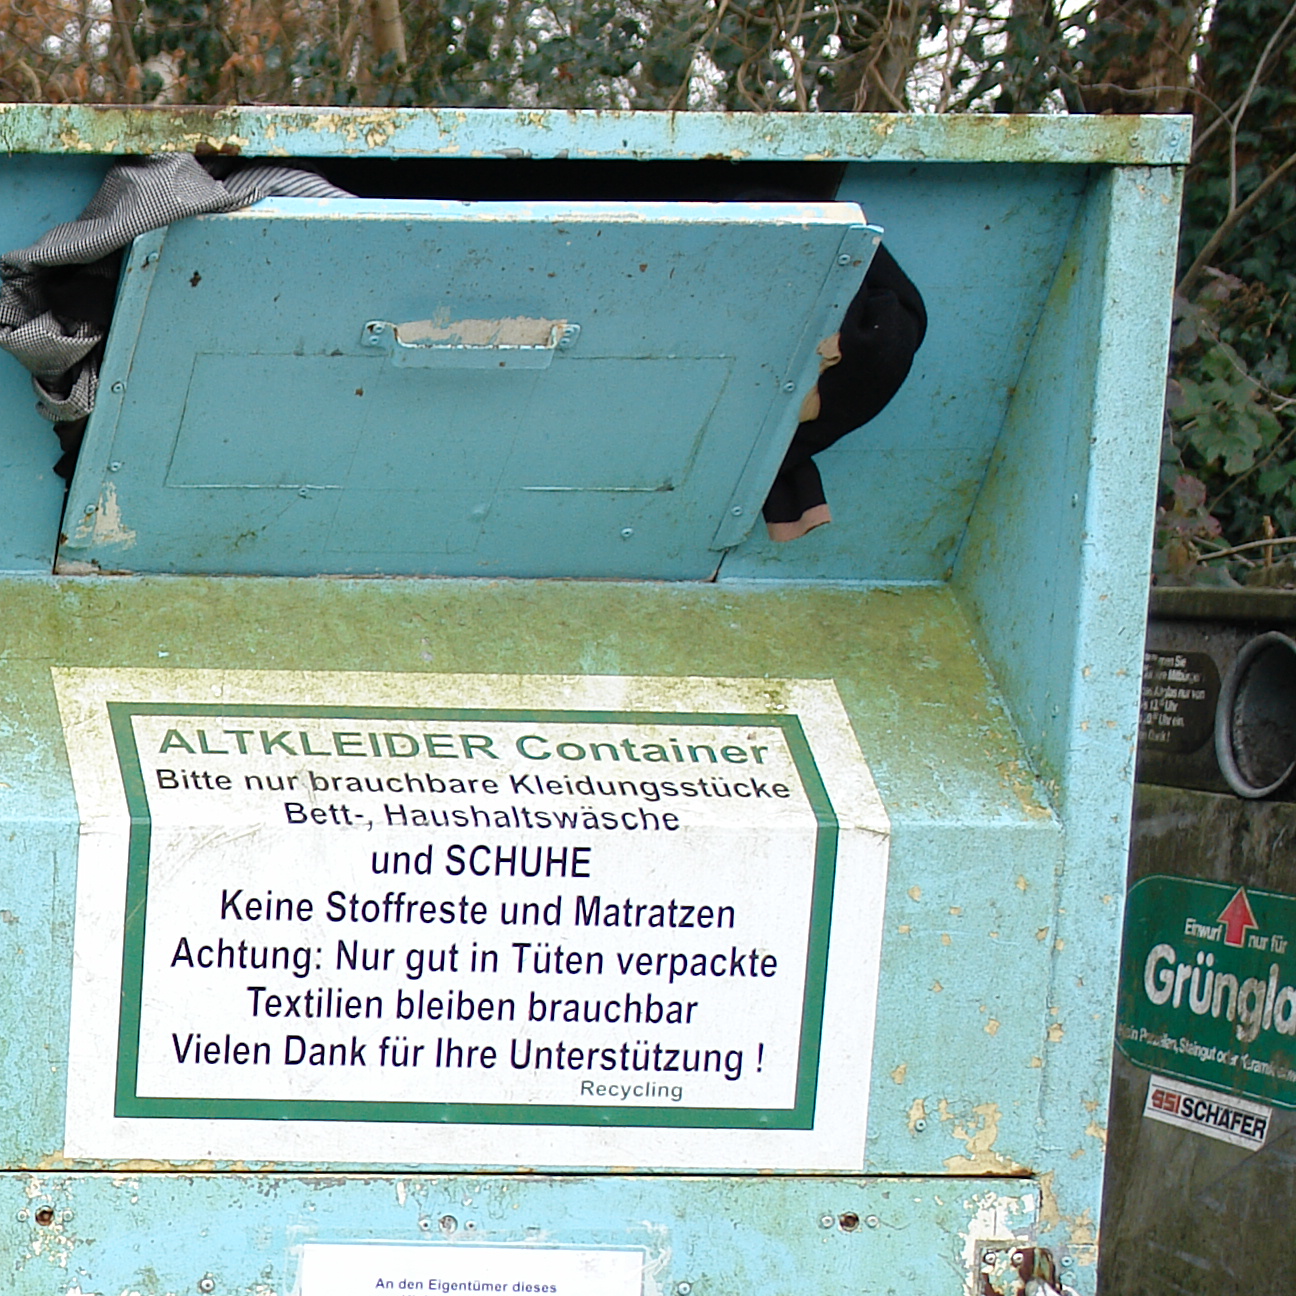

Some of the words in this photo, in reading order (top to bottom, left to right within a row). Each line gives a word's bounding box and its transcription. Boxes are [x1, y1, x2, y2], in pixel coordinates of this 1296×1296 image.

[158, 728, 500, 760] ALTKLEIDER
[515, 734, 769, 764] Container
[155, 768, 233, 791] Bitte
[244, 773, 300, 792] nur
[307, 770, 500, 794] brauchbare
[509, 773, 792, 802] Kleidungsstücke
[283, 801, 374, 832] Bett-,
[383, 802, 681, 832] Haushaltswäsche
[370, 843, 434, 876] und
[444, 844, 593, 878] SCHUHE
[220, 888, 315, 923] Keine
[325, 890, 489, 925] Stoffreste
[499, 894, 563, 926] und
[573, 895, 737, 929] Matratzen
[1184, 916, 1224, 942] Einwurf
[1247, 933, 1269, 951] nur
[1270, 934, 1289, 953] für
[169, 936, 323, 979] Achtung:
[335, 939, 397, 971] Nur
[404, 942, 460, 981] gut
[470, 940, 499, 974] in
[511, 941, 605, 976] Tüten
[615, 945, 780, 985] verpackte
[246, 985, 384, 1020] Textilien
[395, 988, 516, 1022] bleiben
[527, 990, 700, 1026] brauchbar
[171, 1032, 272, 1066] Vielen
[283, 1034, 368, 1067] Dank
[378, 1035, 426, 1068] für
[435, 1037, 498, 1070] Ihre
[509, 1037, 744, 1082] Unterstützung
[755, 1042, 766, 1074] !
[579, 1079, 684, 1102] Recycling
[1181, 1097, 1267, 1140] SCHÄFER
[374, 1277, 395, 1290] An
[398, 1278, 424, 1290] den
[427, 1278, 509, 1294] Eigentümer
[511, 1281, 558, 1294] dieses
